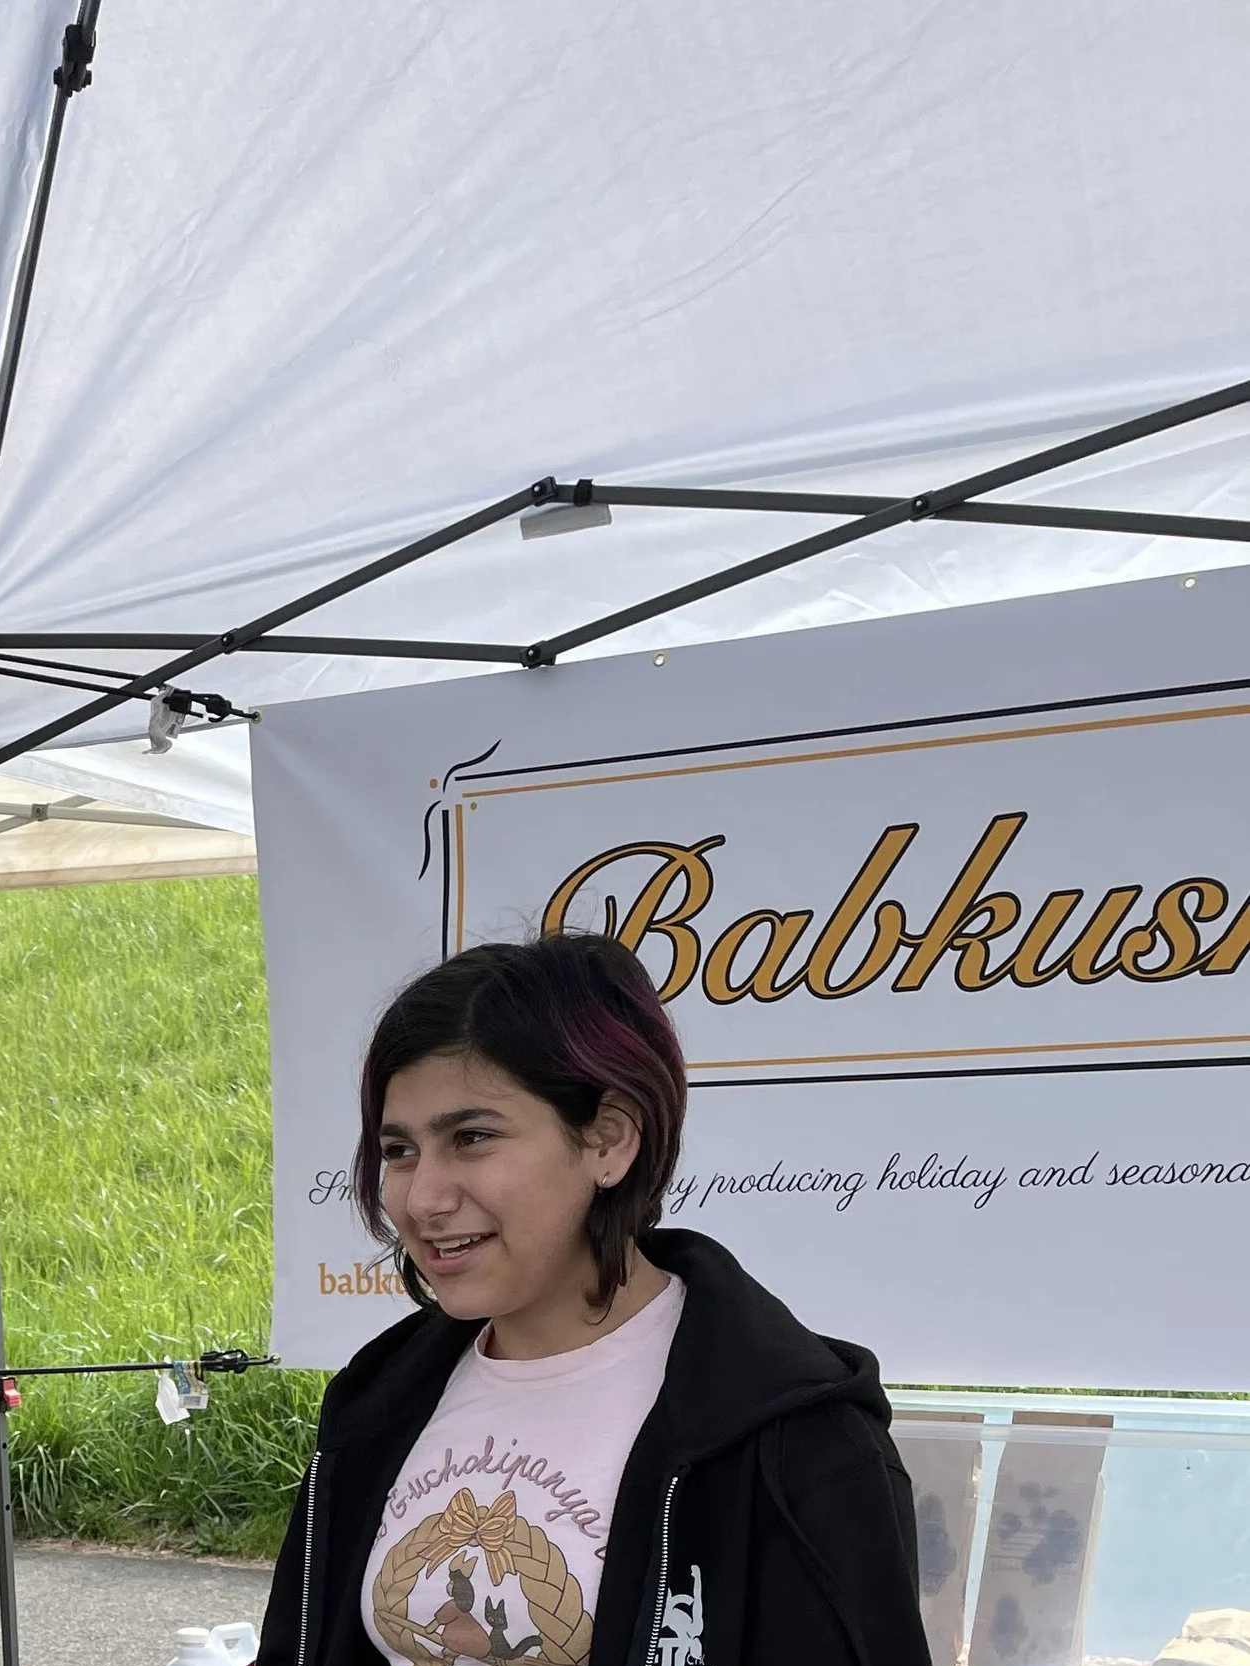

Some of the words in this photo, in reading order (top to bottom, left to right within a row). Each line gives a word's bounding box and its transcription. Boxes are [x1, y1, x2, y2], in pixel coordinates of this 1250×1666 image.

[541, 812, 1250, 1005] Babkus
[699, 1160, 867, 1212] producing
[877, 1152, 1008, 1209] holiday
[1019, 1151, 1100, 1187] and
[1105, 1162, 1250, 1186] seasona
